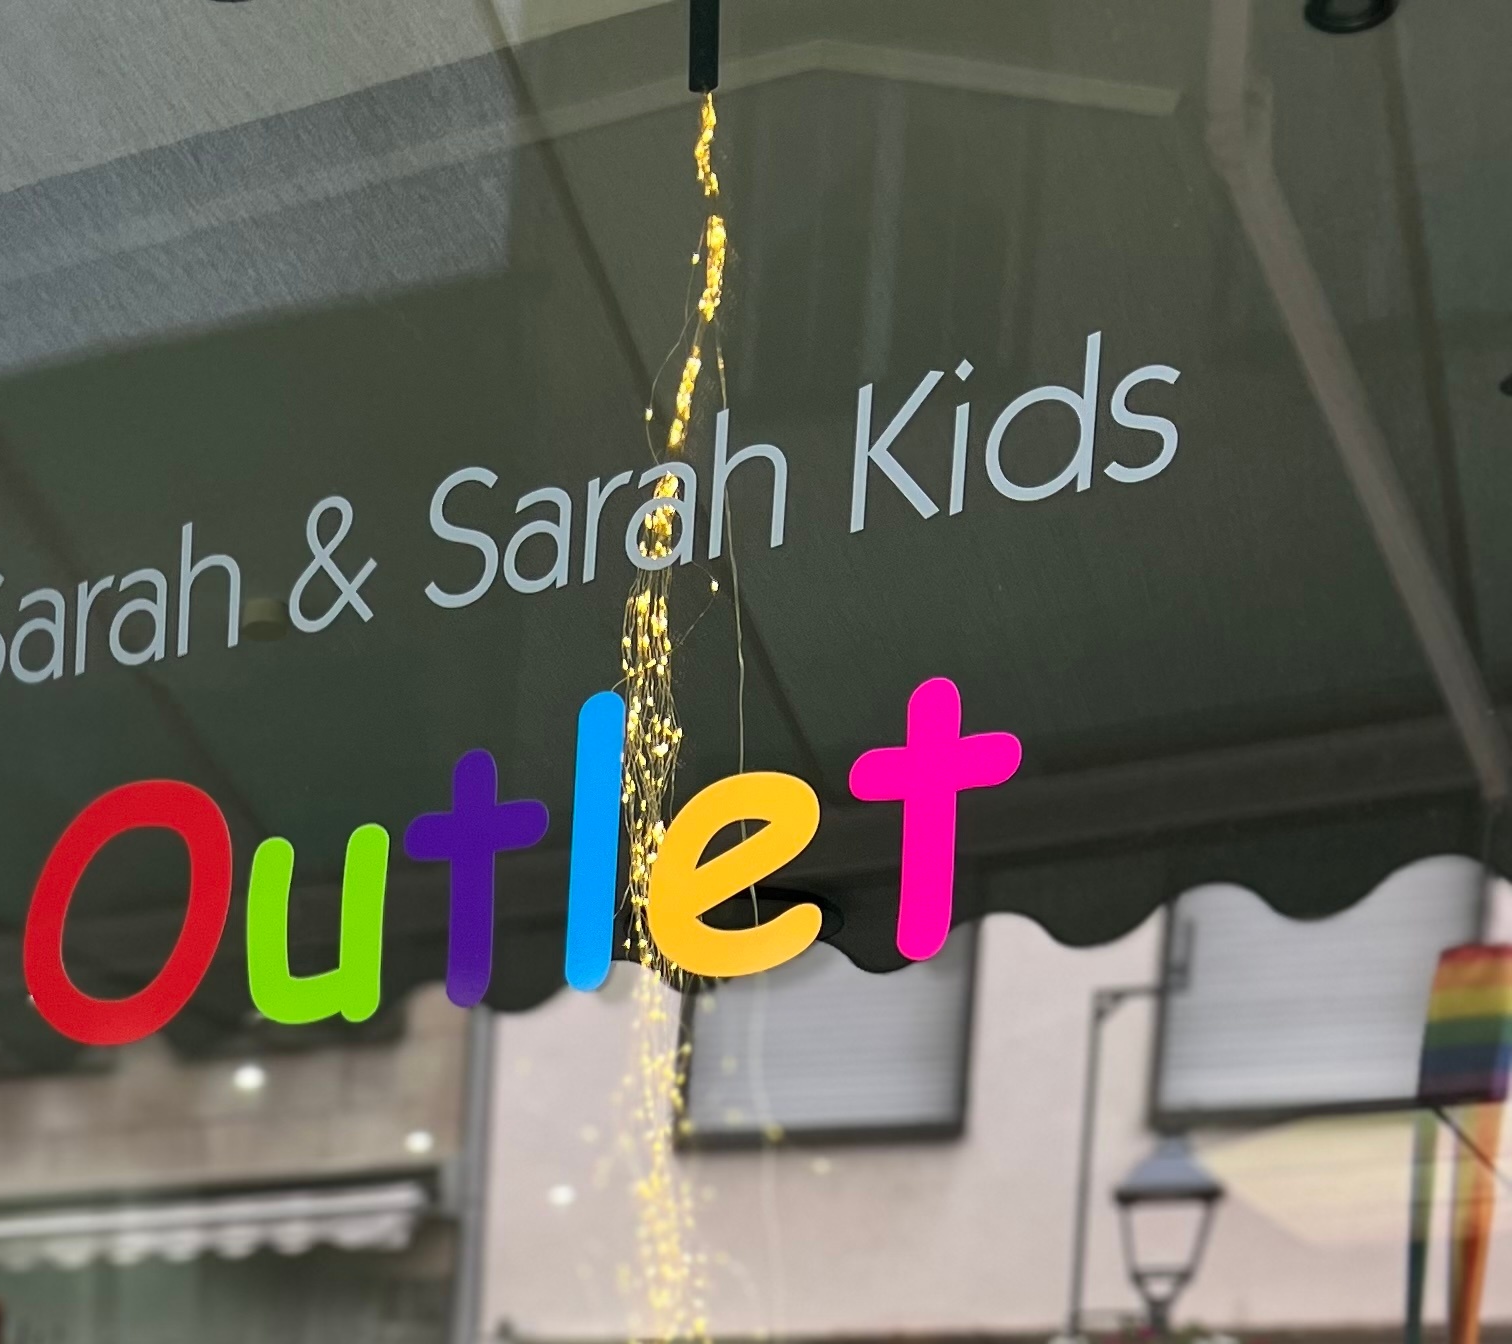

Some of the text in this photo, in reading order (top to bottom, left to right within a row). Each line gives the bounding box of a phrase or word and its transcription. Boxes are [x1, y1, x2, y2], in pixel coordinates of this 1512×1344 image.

[288, 495, 378, 634] &
[424, 409, 790, 610] Sarah
[848, 331, 1182, 533] Kids
[22, 677, 1023, 1047] Outlet
